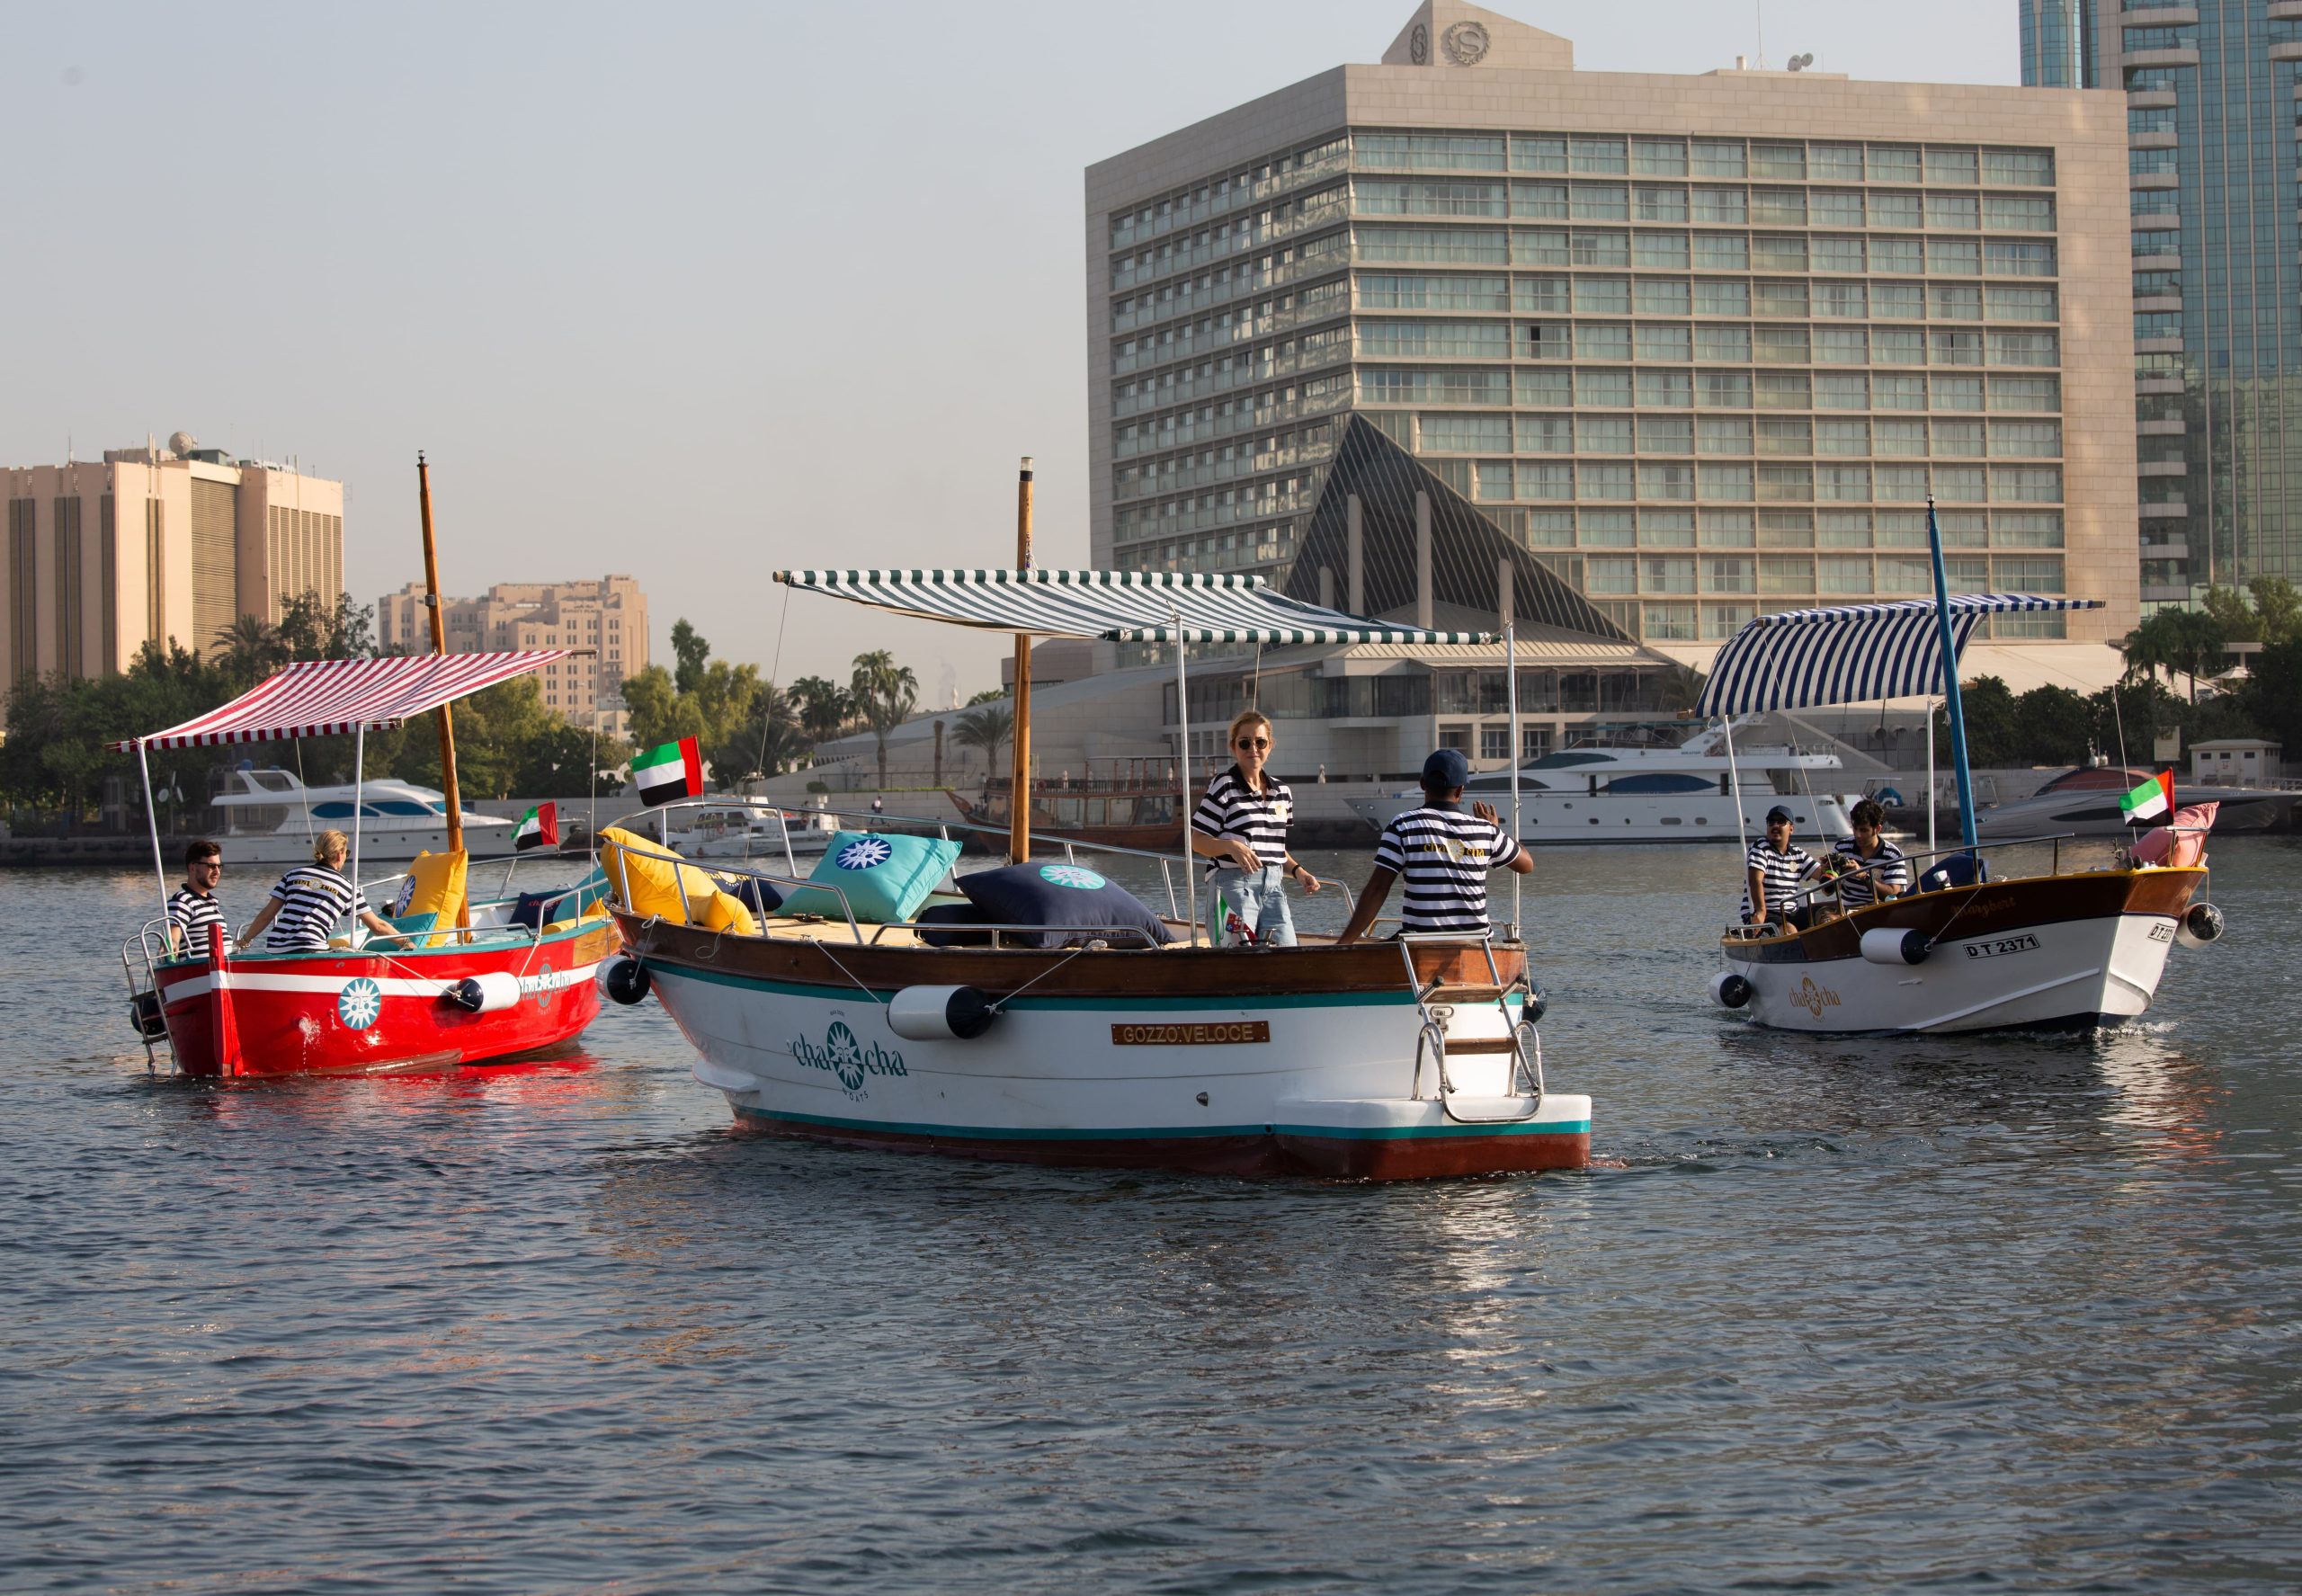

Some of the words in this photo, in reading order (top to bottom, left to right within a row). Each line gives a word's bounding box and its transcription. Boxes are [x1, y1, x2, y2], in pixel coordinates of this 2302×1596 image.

[1996, 936, 2037, 953] 2371
[1820, 985, 1842, 1007] cha
[792, 1032, 832, 1071] cha
[864, 1039, 908, 1077] cha
